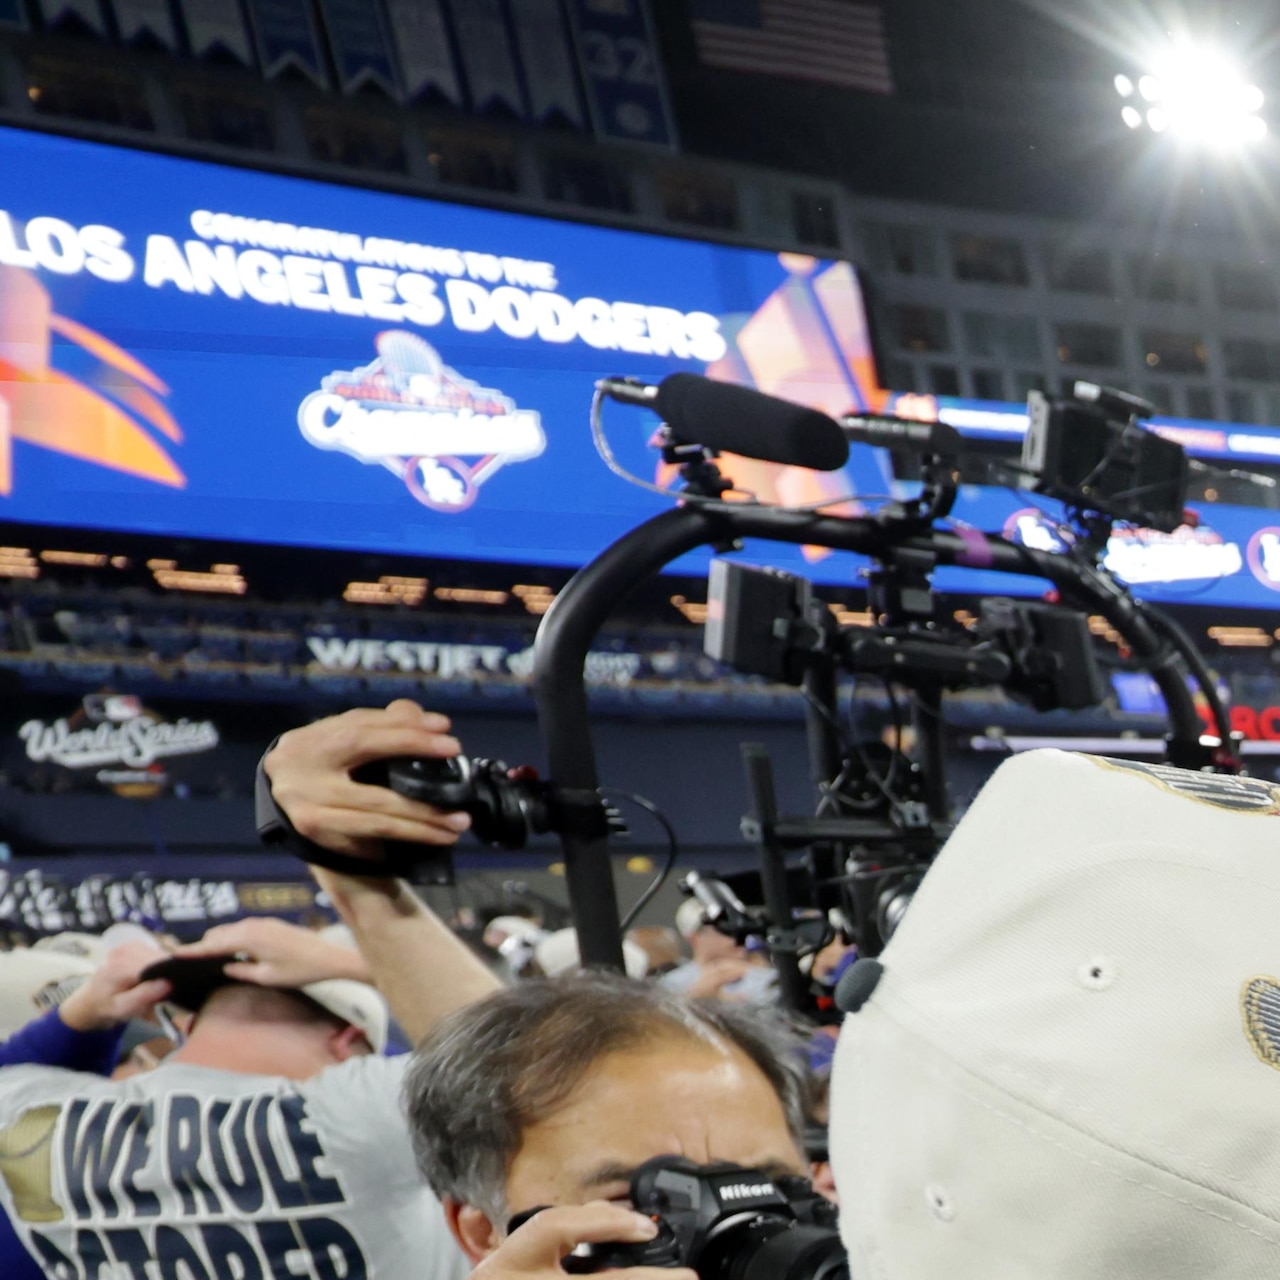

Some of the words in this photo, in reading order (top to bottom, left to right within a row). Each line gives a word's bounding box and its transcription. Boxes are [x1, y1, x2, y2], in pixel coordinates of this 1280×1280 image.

[0, 209, 135, 282] LOS
[144, 234, 445, 326] ANGELES
[445, 278, 728, 362] DODGERS
[306, 636, 507, 680] WESTJET
[60, 1095, 162, 1222] WE
[162, 1090, 348, 1221] RULE
[719, 1183, 775, 1200] Nikon
